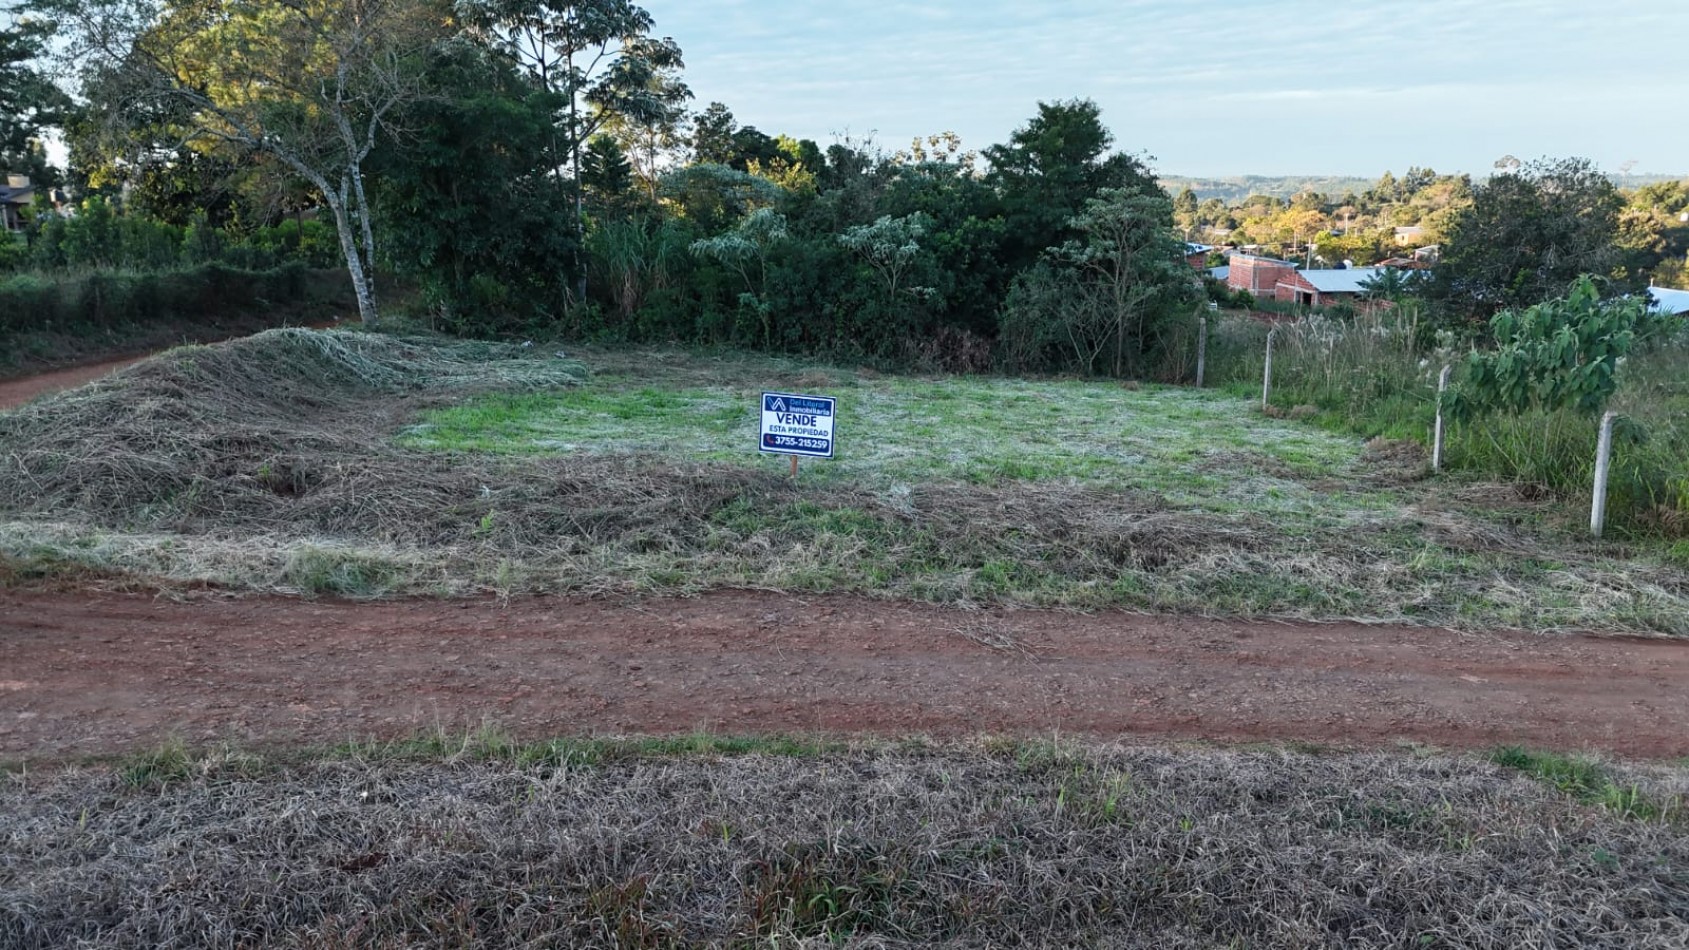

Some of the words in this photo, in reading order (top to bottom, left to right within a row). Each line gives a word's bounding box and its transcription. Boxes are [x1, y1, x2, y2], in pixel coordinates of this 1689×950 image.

[789, 406, 830, 415] Inmobiliaria
[776, 413, 817, 427] VENDE
[769, 425, 786, 433] ESTA
[788, 427, 829, 437] PROPIEDAD
[775, 436, 828, 449] 3755-215259
